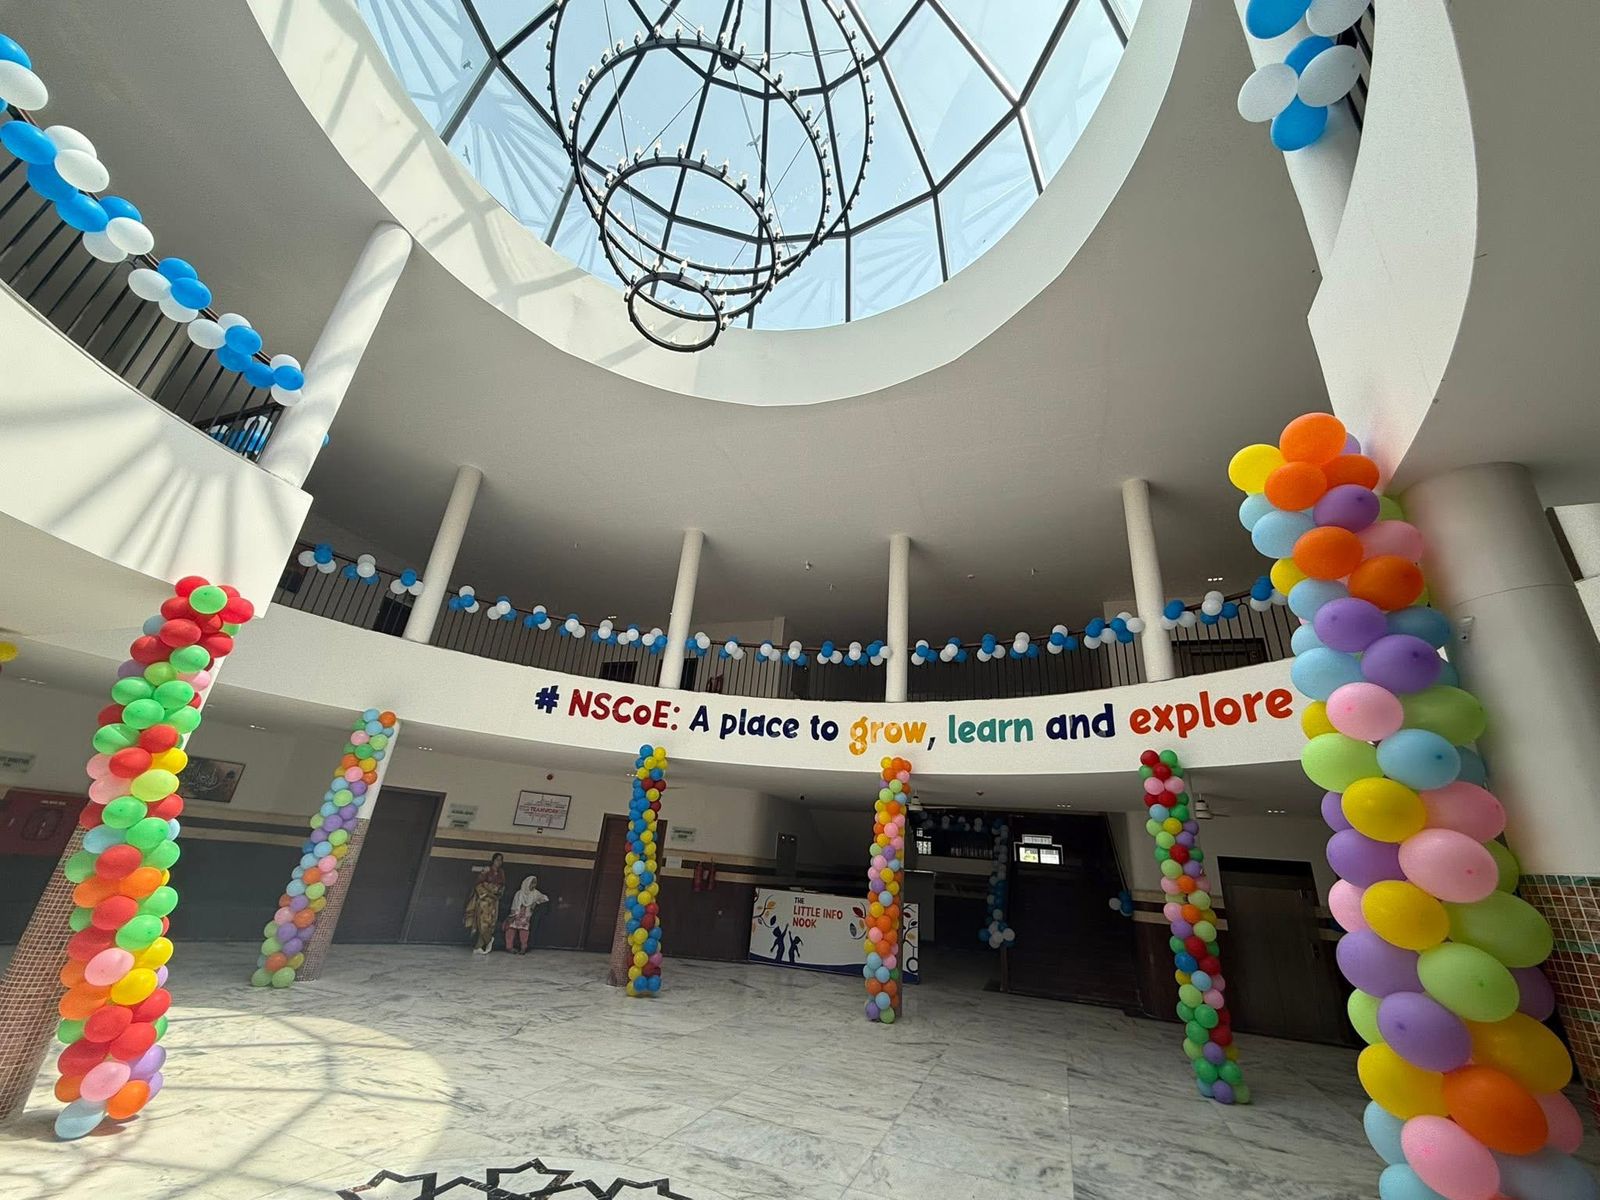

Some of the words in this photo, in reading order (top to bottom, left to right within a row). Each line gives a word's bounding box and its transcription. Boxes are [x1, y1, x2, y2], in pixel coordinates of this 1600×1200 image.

[535, 685, 560, 714] #
[568, 688, 681, 731] NSCoE:
[689, 705, 710, 732] A
[719, 708, 799, 740] place
[810, 714, 839, 741] to
[848, 715, 936, 757] grow,
[948, 714, 1034, 744] learn
[1045, 703, 1116, 741] and
[1129, 688, 1293, 739] explore
[793, 905, 821, 917] LITTLE
[823, 908, 843, 920] INFO
[792, 917, 817, 928] NOOK
